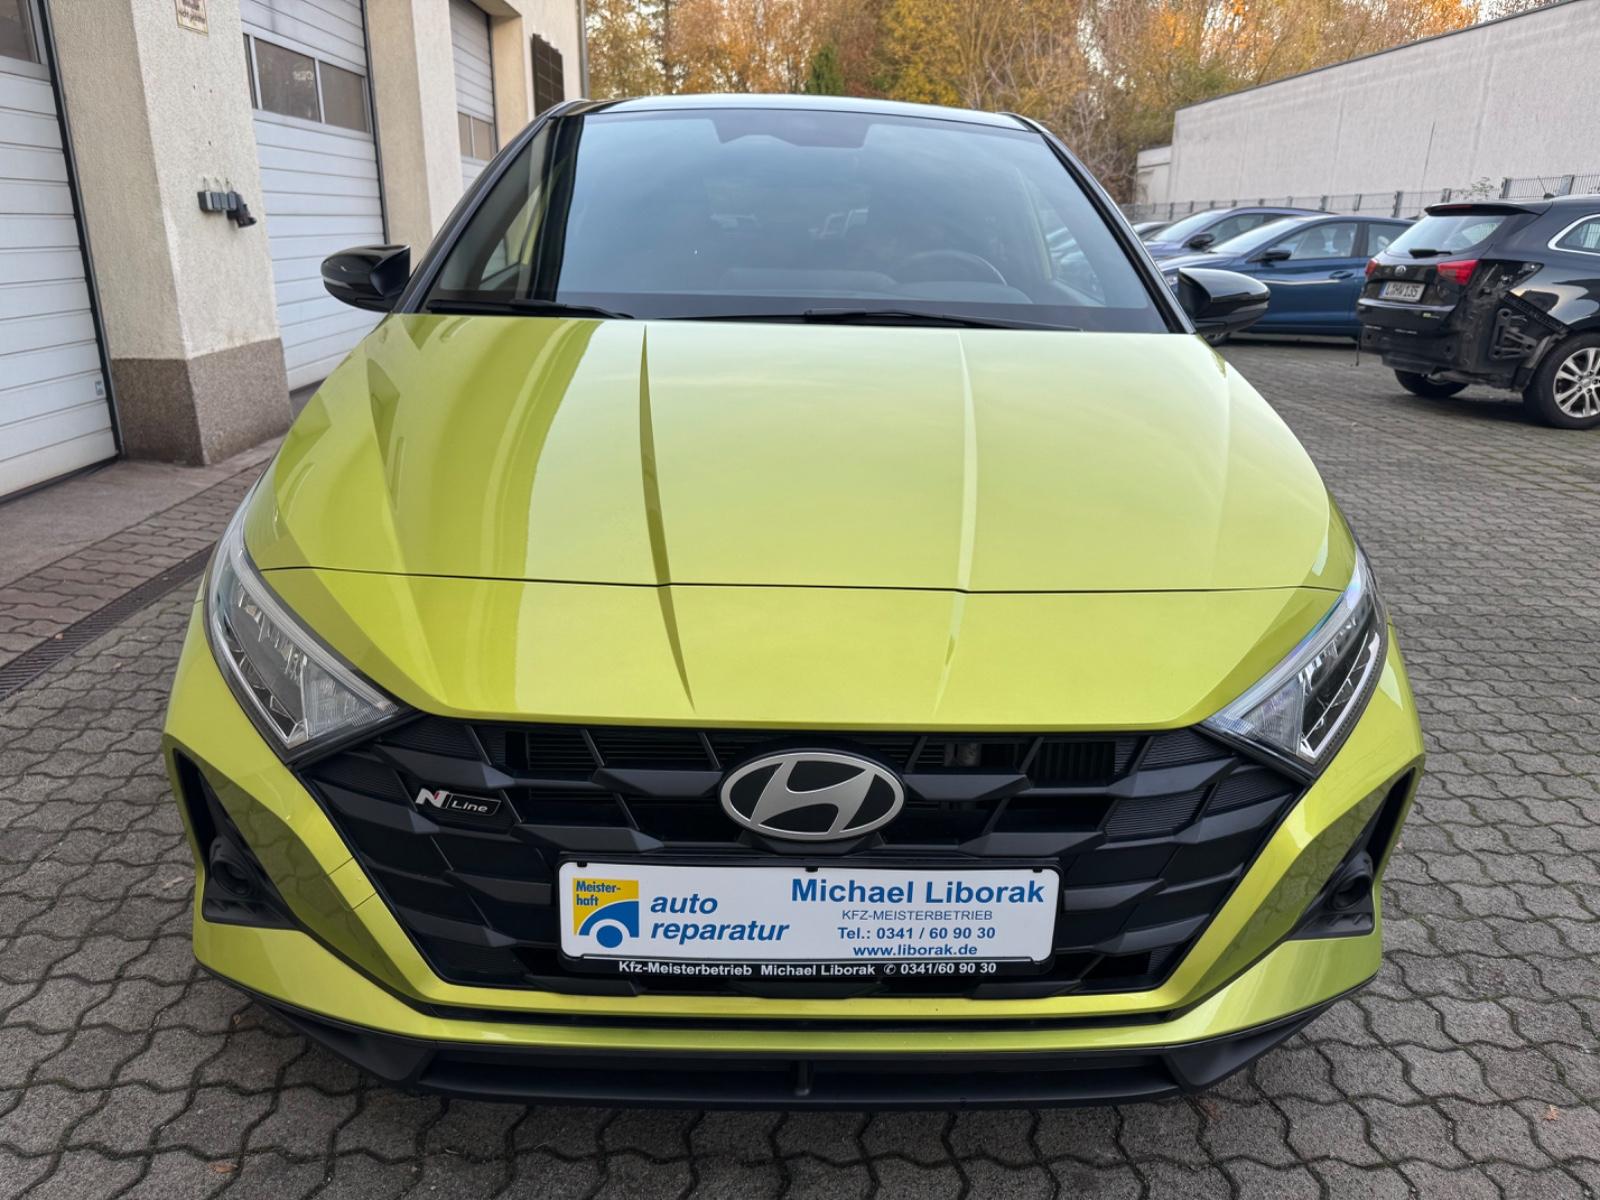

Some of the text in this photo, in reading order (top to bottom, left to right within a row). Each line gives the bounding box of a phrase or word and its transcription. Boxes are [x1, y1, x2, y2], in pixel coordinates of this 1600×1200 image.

[415, 788, 488, 812] N Line
[576, 880, 621, 893] Meister-
[792, 878, 1045, 904] Michael Liborak
[576, 894, 599, 906] haft
[650, 893, 718, 914] auto
[842, 910, 993, 921] KFZ-MEISTERBETRIEB
[650, 921, 790, 945] reparatur
[837, 927, 996, 940] Tel.: 0341 / 60 90 30
[853, 944, 978, 956] www.liborak.de
[618, 960, 997, 976] Kfz-Meisterbetrieb Michael Liborak 0341/60 90 30
